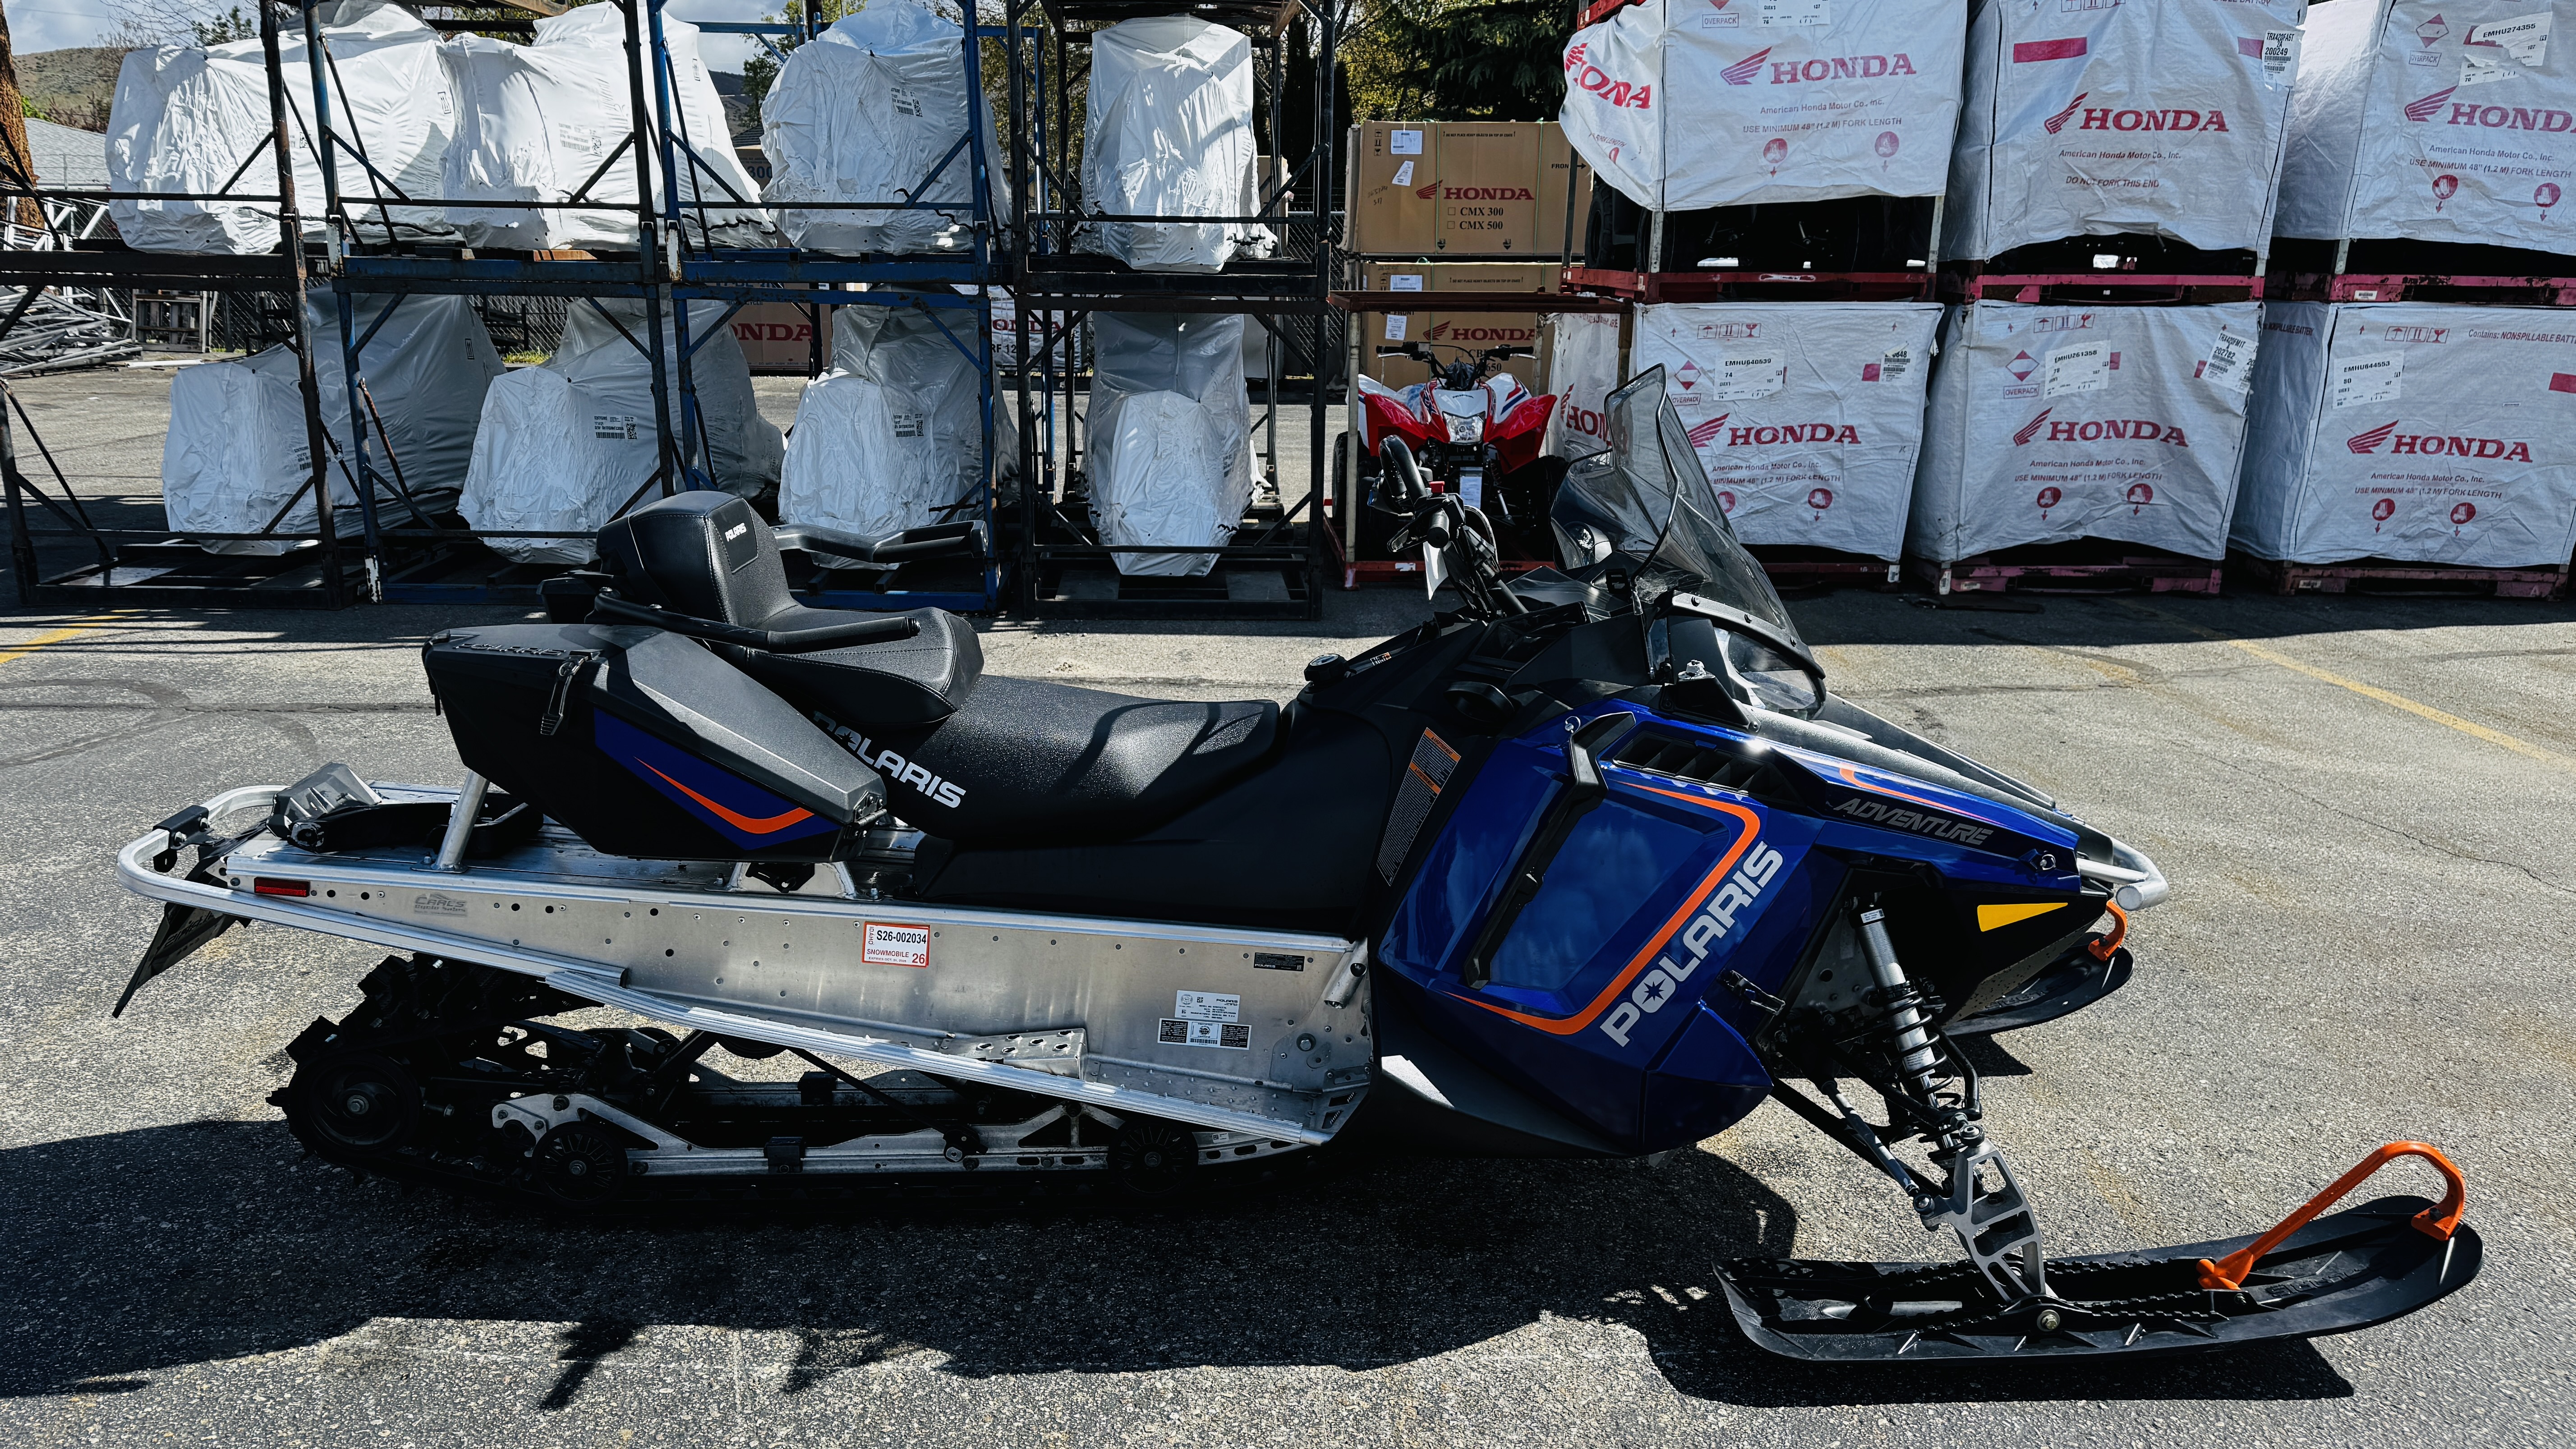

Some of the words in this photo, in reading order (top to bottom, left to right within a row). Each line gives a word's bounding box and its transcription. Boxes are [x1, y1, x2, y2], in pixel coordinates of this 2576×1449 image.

[2483, 23, 2536, 38] EMHU274355
[2265, 47, 2288, 55] 200249
[1771, 53, 1916, 85] HONDA
[1802, 103, 1826, 111] Honda
[2080, 108, 2229, 132] HONDA
[2447, 103, 2576, 133] HOND
[1762, 124, 1799, 133] MINIMUM
[1817, 121, 1830, 130] (1.2
[1831, 120, 1841, 129] M)
[2059, 150, 2097, 158] American
[2429, 145, 2467, 154] American
[2469, 147, 2495, 156] Honda
[2497, 150, 2521, 159] Motor
[2540, 153, 2554, 161] Inc.
[2428, 161, 2467, 170] MINIMUM
[2484, 165, 2497, 173] (1.2
[2500, 166, 2509, 175] M)
[2511, 167, 2534, 175] FORK
[2536, 169, 2571, 178] LENGTH
[1444, 188, 1534, 200] HONDA
[1460, 207, 1485, 216] CMX
[1487, 207, 1504, 216] 300
[1459, 221, 1485, 230] CMX
[1487, 221, 1503, 230] 500
[730, 323, 813, 341] NDA
[2469, 329, 2499, 339] Contains:
[2501, 331, 2555, 342] NONSPILLABLE
[1486, 363, 1502, 372] 650
[2006, 387, 2038, 395] OVERPACK
[1728, 423, 1861, 447] HONDA
[2047, 420, 2189, 447] HONDA
[2391, 434, 2533, 463] HONDA
[2128, 472, 2162, 480] LENGTH
[2406, 473, 2430, 481] Honda
[2467, 489, 2502, 498] LENGTH
[725, 522, 747, 542] POLARIS
[1833, 797, 1993, 846] ADVENTURE
[877, 930, 926, 944] S26-002034
[1600, 841, 1785, 1048] POLARIS
[867, 949, 909, 957] SNOWMOBILE
[912, 953, 925, 964] 26
